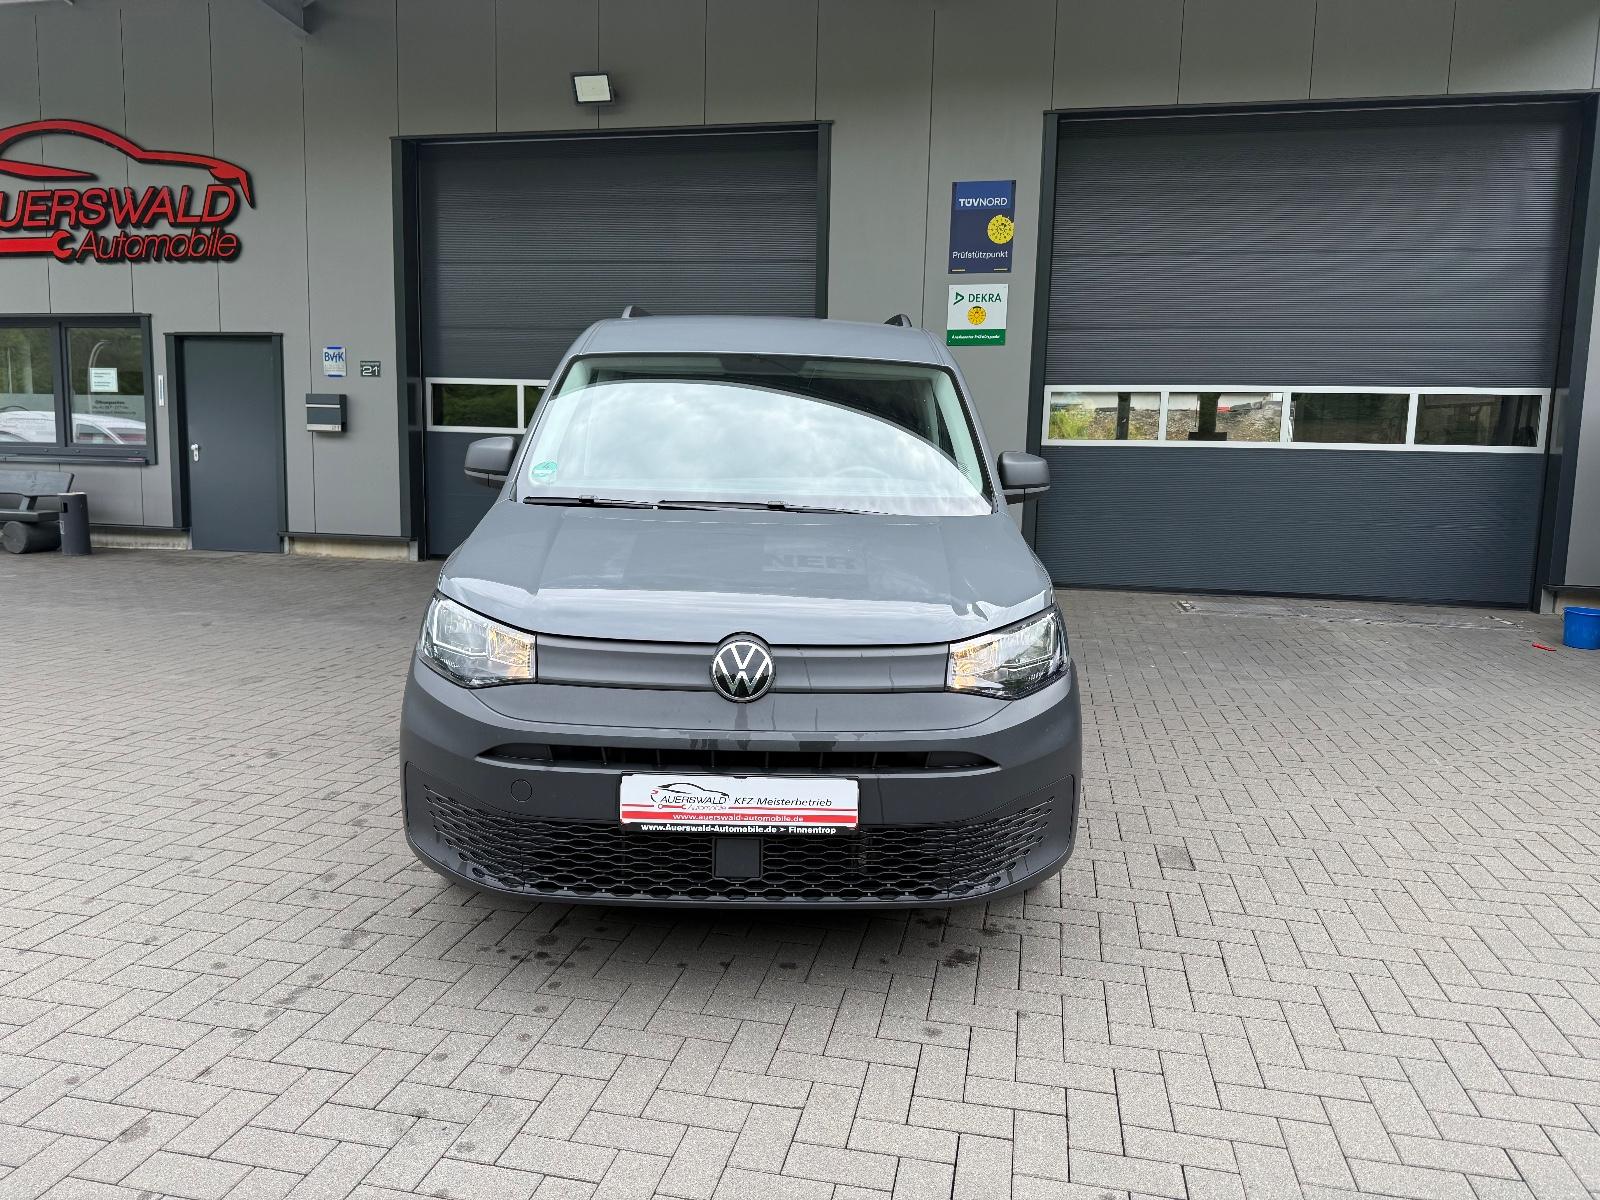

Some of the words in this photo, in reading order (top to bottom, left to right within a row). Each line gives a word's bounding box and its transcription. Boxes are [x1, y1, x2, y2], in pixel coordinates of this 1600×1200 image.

[75, 226, 238, 259] Automobile
[952, 250, 1008, 260] Prüfstützpunkt
[968, 293, 1002, 303] DEKRA
[362, 366, 378, 376] 21
[660, 795, 727, 805] AUERSWALD
[733, 797, 754, 805] KFZ
[756, 797, 832, 807] Meisterbetrieb
[672, 814, 804, 823] www.auerswald-automobile.de
[640, 823, 777, 834] www.Auerswald-Automobile.de
[788, 826, 837, 836] Finnentrop
